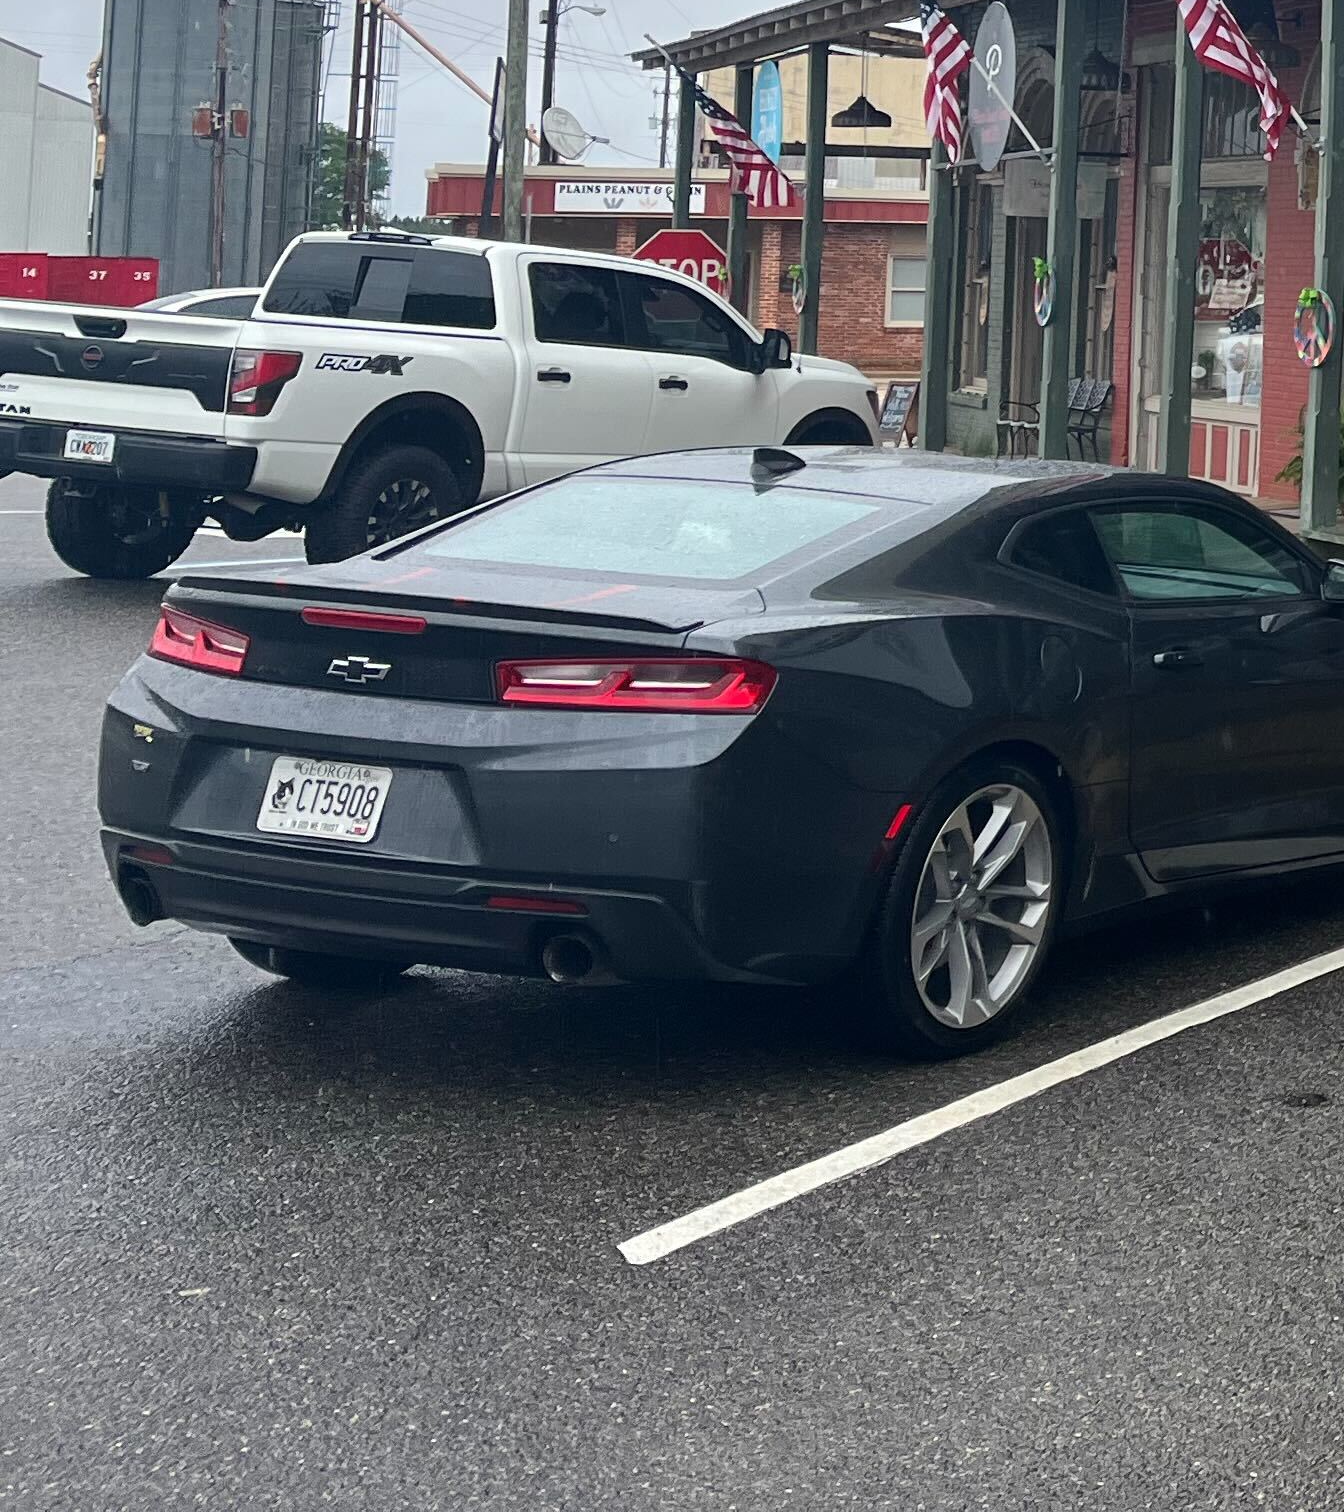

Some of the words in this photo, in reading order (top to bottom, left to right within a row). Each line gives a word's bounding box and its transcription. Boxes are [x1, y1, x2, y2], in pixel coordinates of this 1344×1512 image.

[559, 184, 600, 194] PLAINS
[604, 185, 650, 194] PEANUT
[654, 185, 662, 194] &
[22, 267, 36, 278] 14
[88, 270, 107, 280] 37
[133, 271, 151, 281] 35
[300, 762, 361, 780] GEORGIA
[297, 779, 379, 819] CT5908
